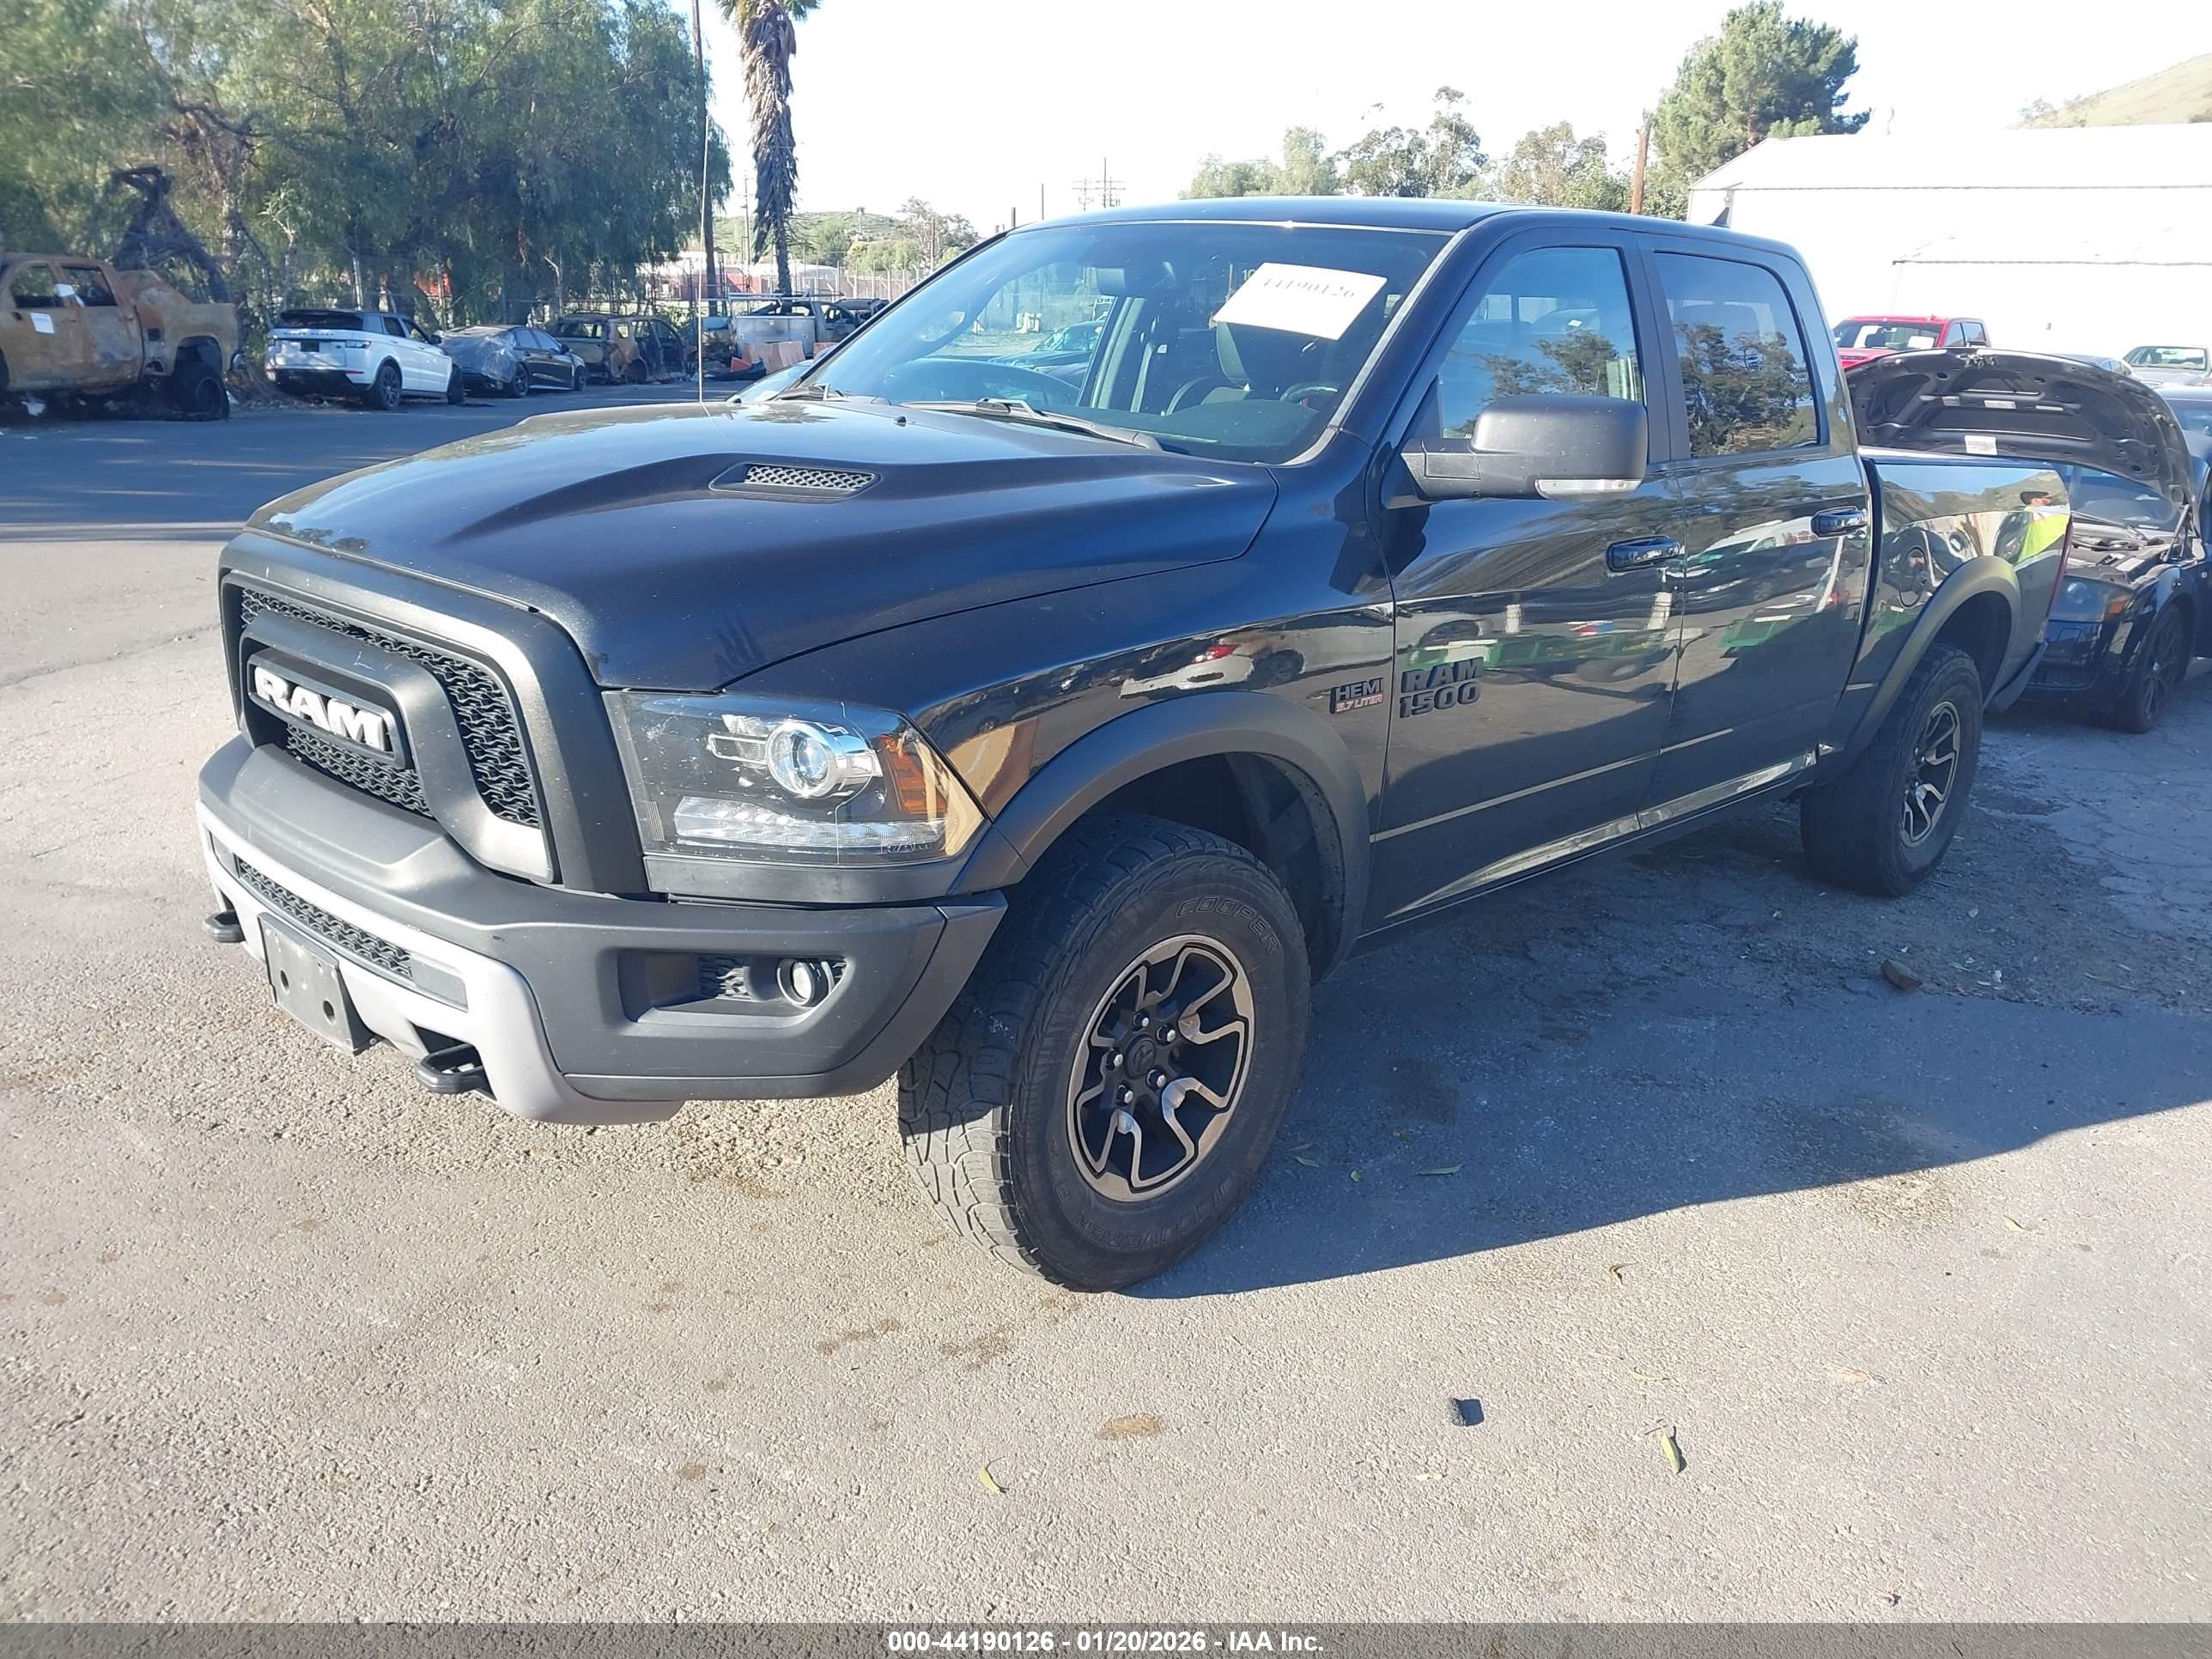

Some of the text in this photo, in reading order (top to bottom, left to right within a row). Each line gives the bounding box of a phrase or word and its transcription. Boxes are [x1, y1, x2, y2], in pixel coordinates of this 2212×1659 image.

[1401, 657, 1485, 694] RAM
[254, 666, 385, 751] RAM
[1335, 694, 1383, 713] 5.7 LITER
[1400, 682, 1481, 719] 1500
[1175, 896, 1281, 955] COOPER
